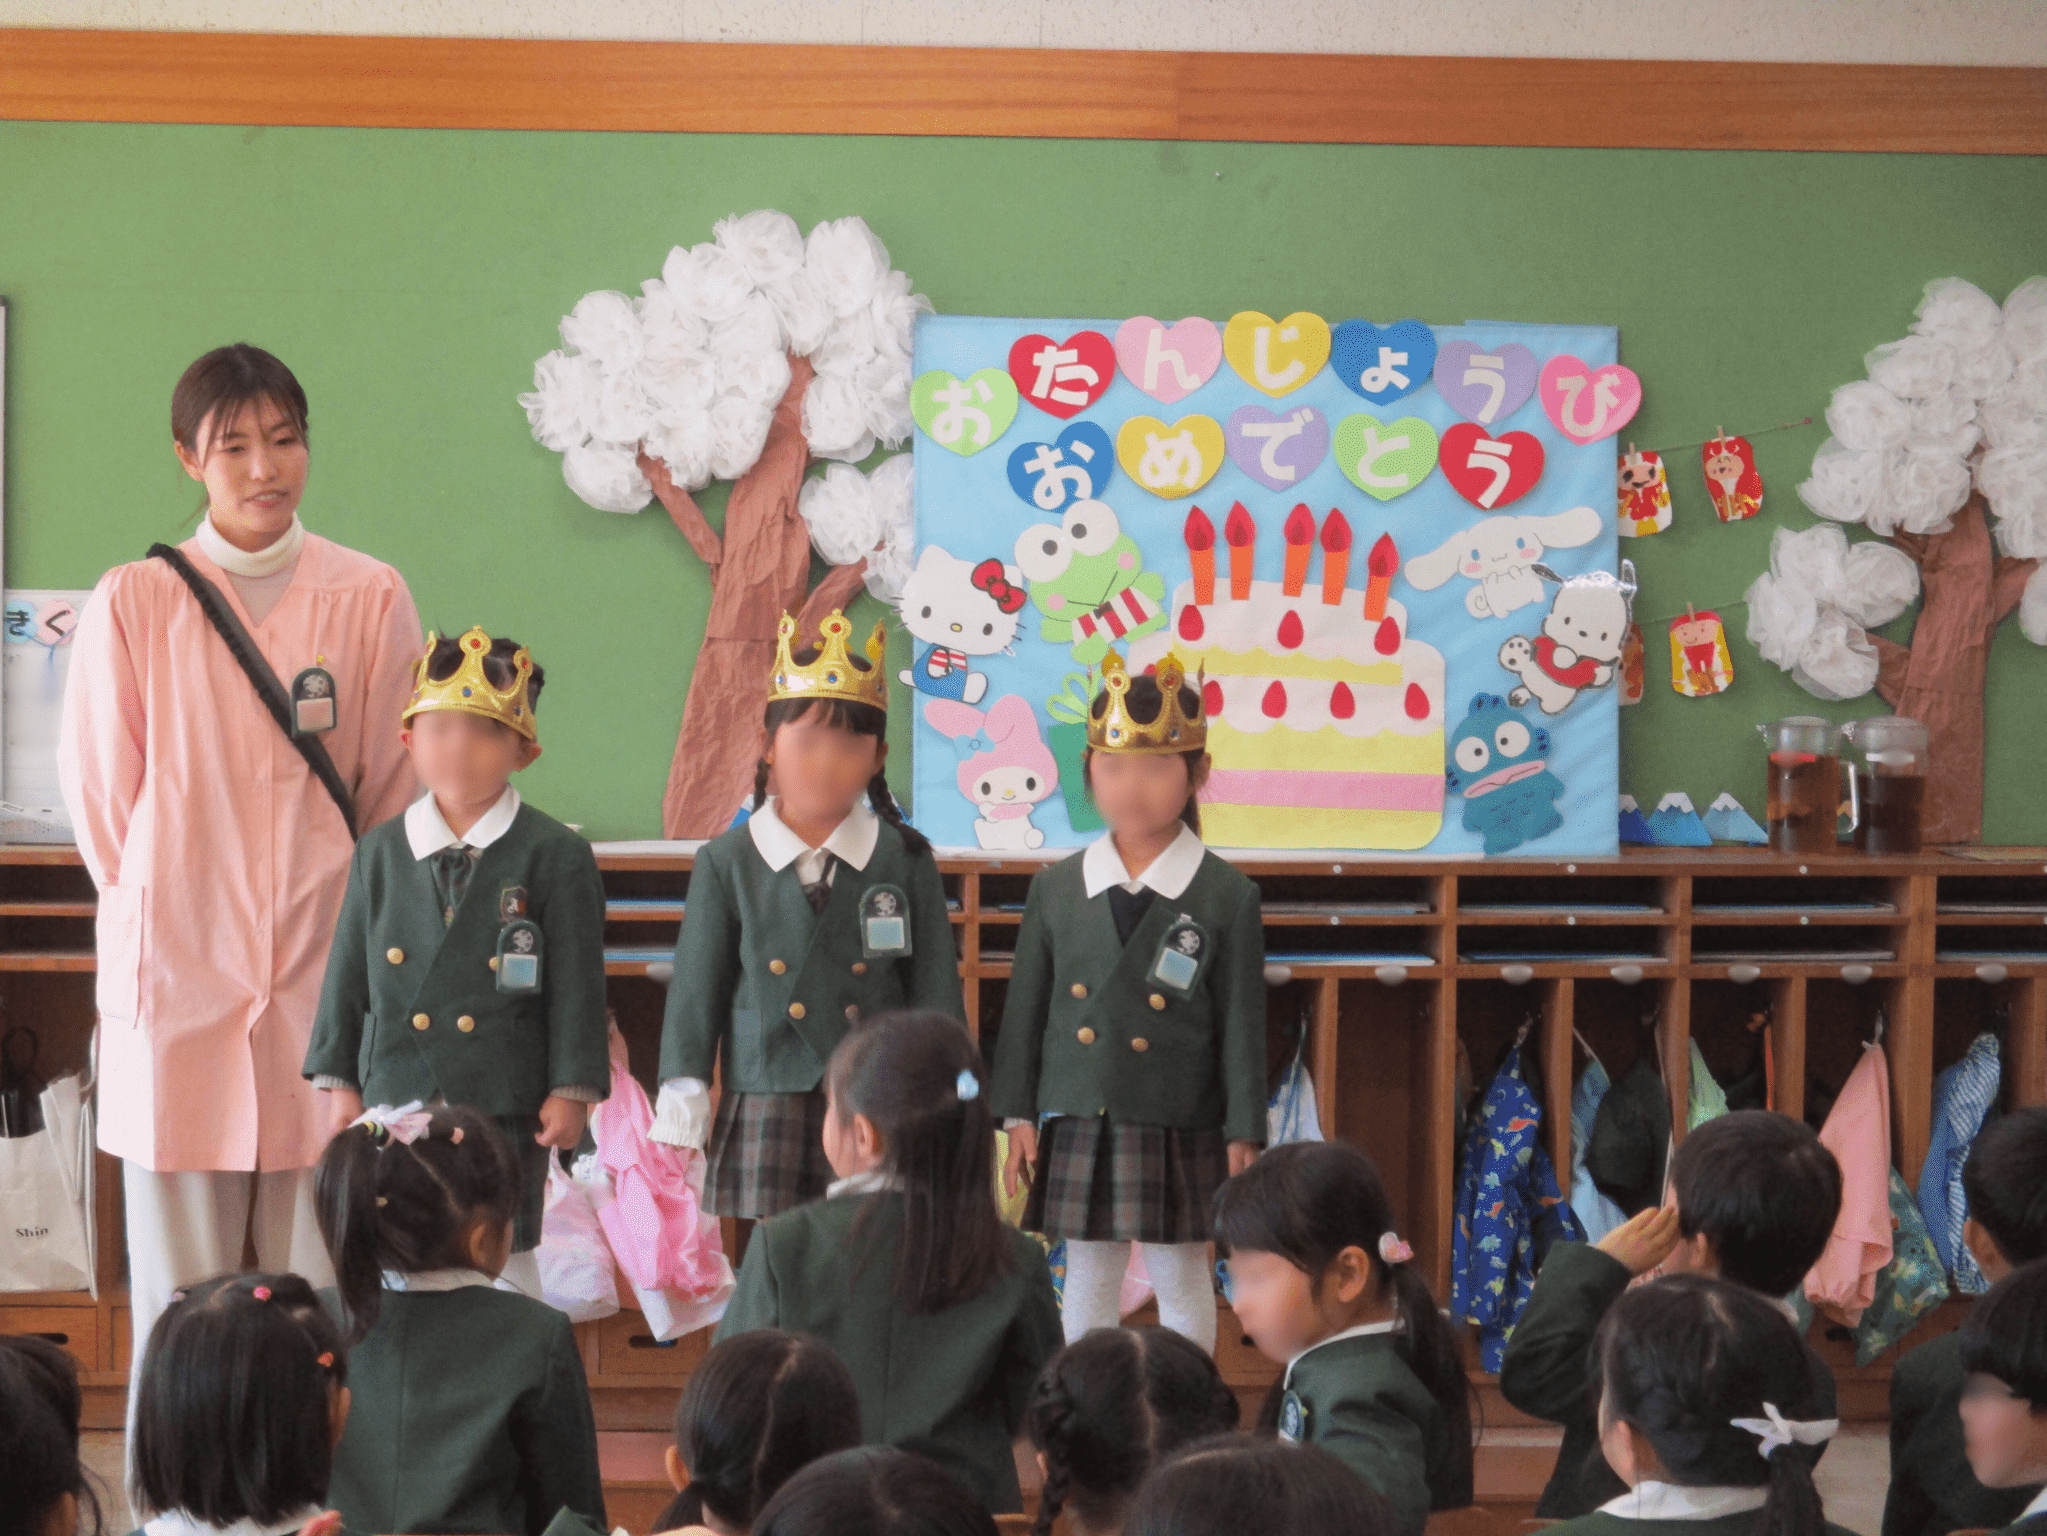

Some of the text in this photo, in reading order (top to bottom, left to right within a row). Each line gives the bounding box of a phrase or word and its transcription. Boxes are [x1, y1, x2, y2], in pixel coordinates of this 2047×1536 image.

[931, 326, 1621, 446] おたんじょうび
[1023, 407, 1513, 511] おめでとう
